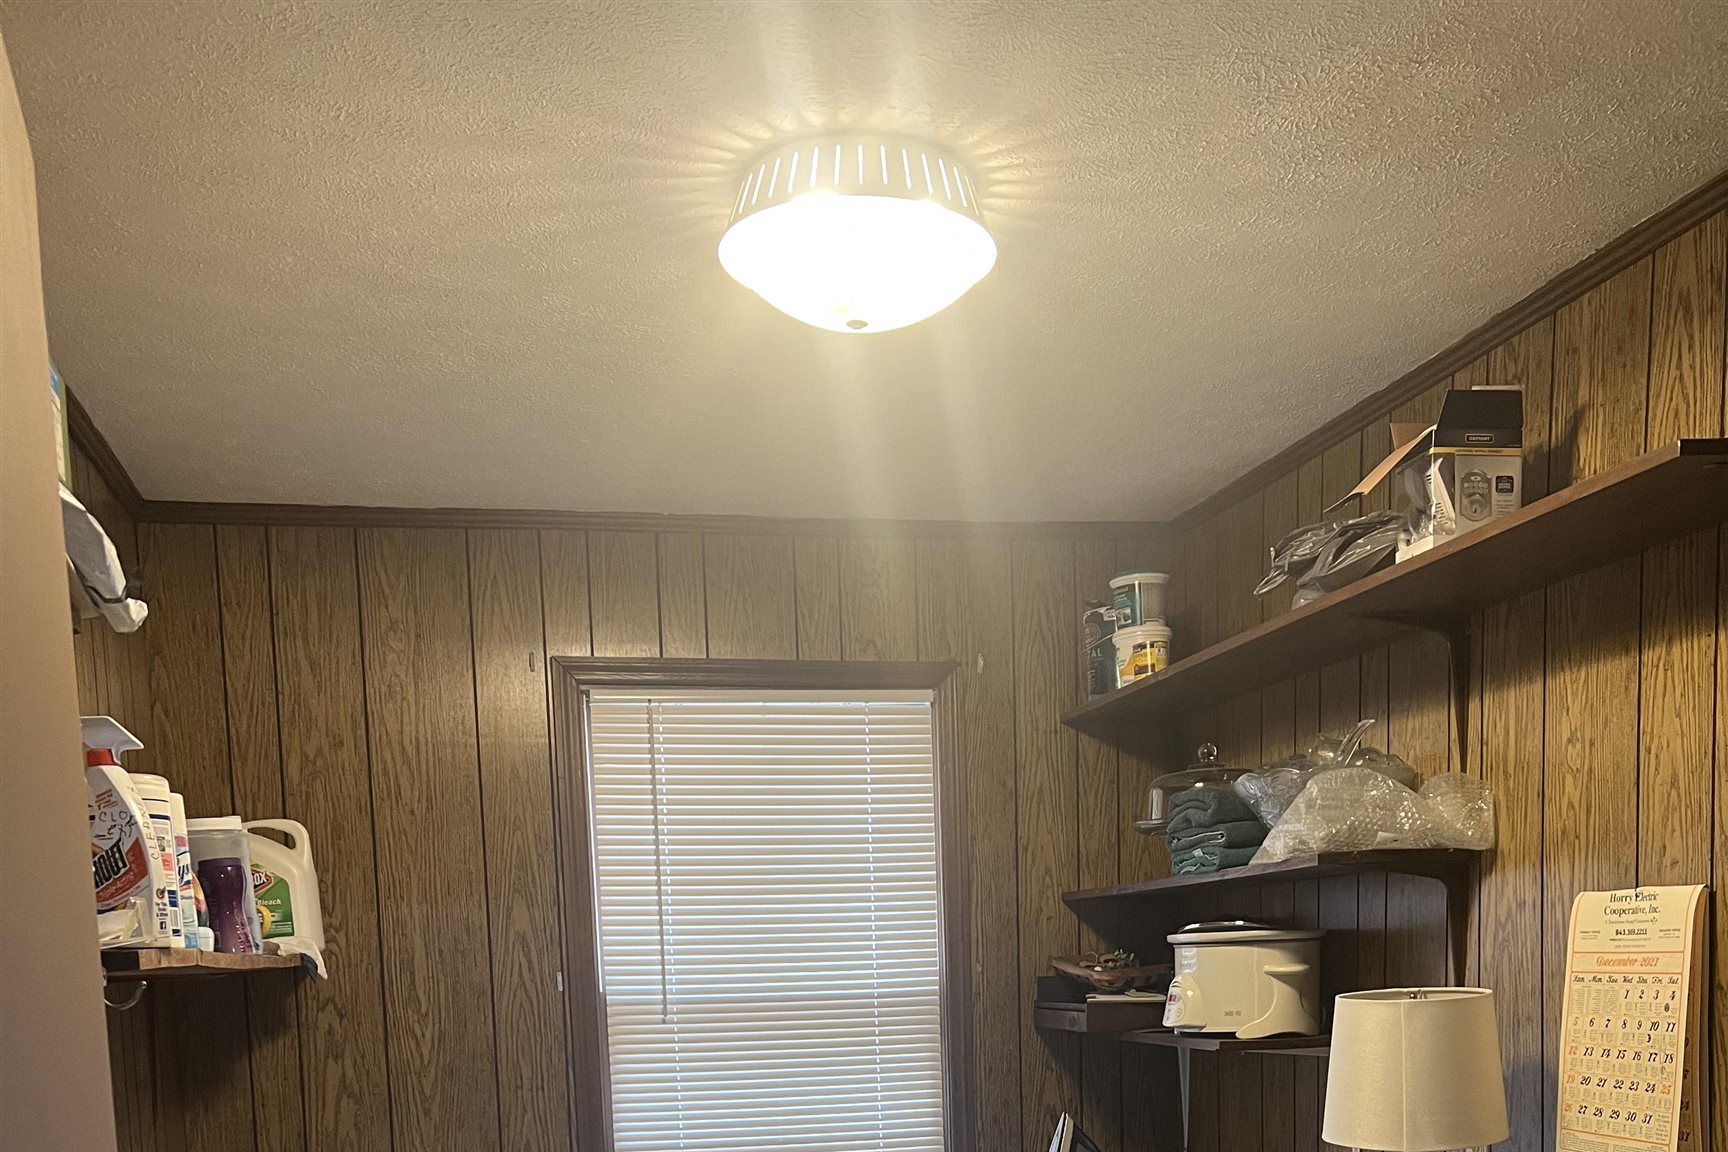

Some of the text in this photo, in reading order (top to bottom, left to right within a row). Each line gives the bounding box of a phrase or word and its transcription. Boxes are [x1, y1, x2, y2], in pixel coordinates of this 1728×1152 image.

[1609, 891, 1659, 905] Horry Electric
[1604, 904, 1661, 917] Cooperative, Inc.
[1596, 955, 1660, 967] December 2021
[1573, 975, 1585, 983] Sun
[1588, 975, 1602, 983] Mon
[1622, 975, 1633, 983] Wed
[1652, 976, 1663, 985] Fri
[1624, 989, 1676, 1000] 1 2 3 4
[1589, 1017, 1595, 1027] 6
[1605, 1019, 1611, 1028] 7
[1622, 1019, 1628, 1029] 8
[1637, 1020, 1642, 1030] 9
[1649, 1021, 1660, 1031] 10
[1665, 1022, 1676, 1032] 11
[1568, 1046, 1674, 1063] 12 13 14 15 16 17 18
[1580, 1076, 1591, 1086] 20
[1596, 1077, 1607, 1087] 21
[1613, 1079, 1624, 1089] 22
[1628, 1080, 1640, 1091] 23
[1645, 1082, 1656, 1093] 24
[1660, 1084, 1671, 1095] 25
[1578, 1104, 1588, 1114] 27
[1593, 1106, 1604, 1117] 28
[1609, 1109, 1620, 1119] 29
[1625, 1111, 1637, 1122] 30
[1642, 1113, 1653, 1124] 31
